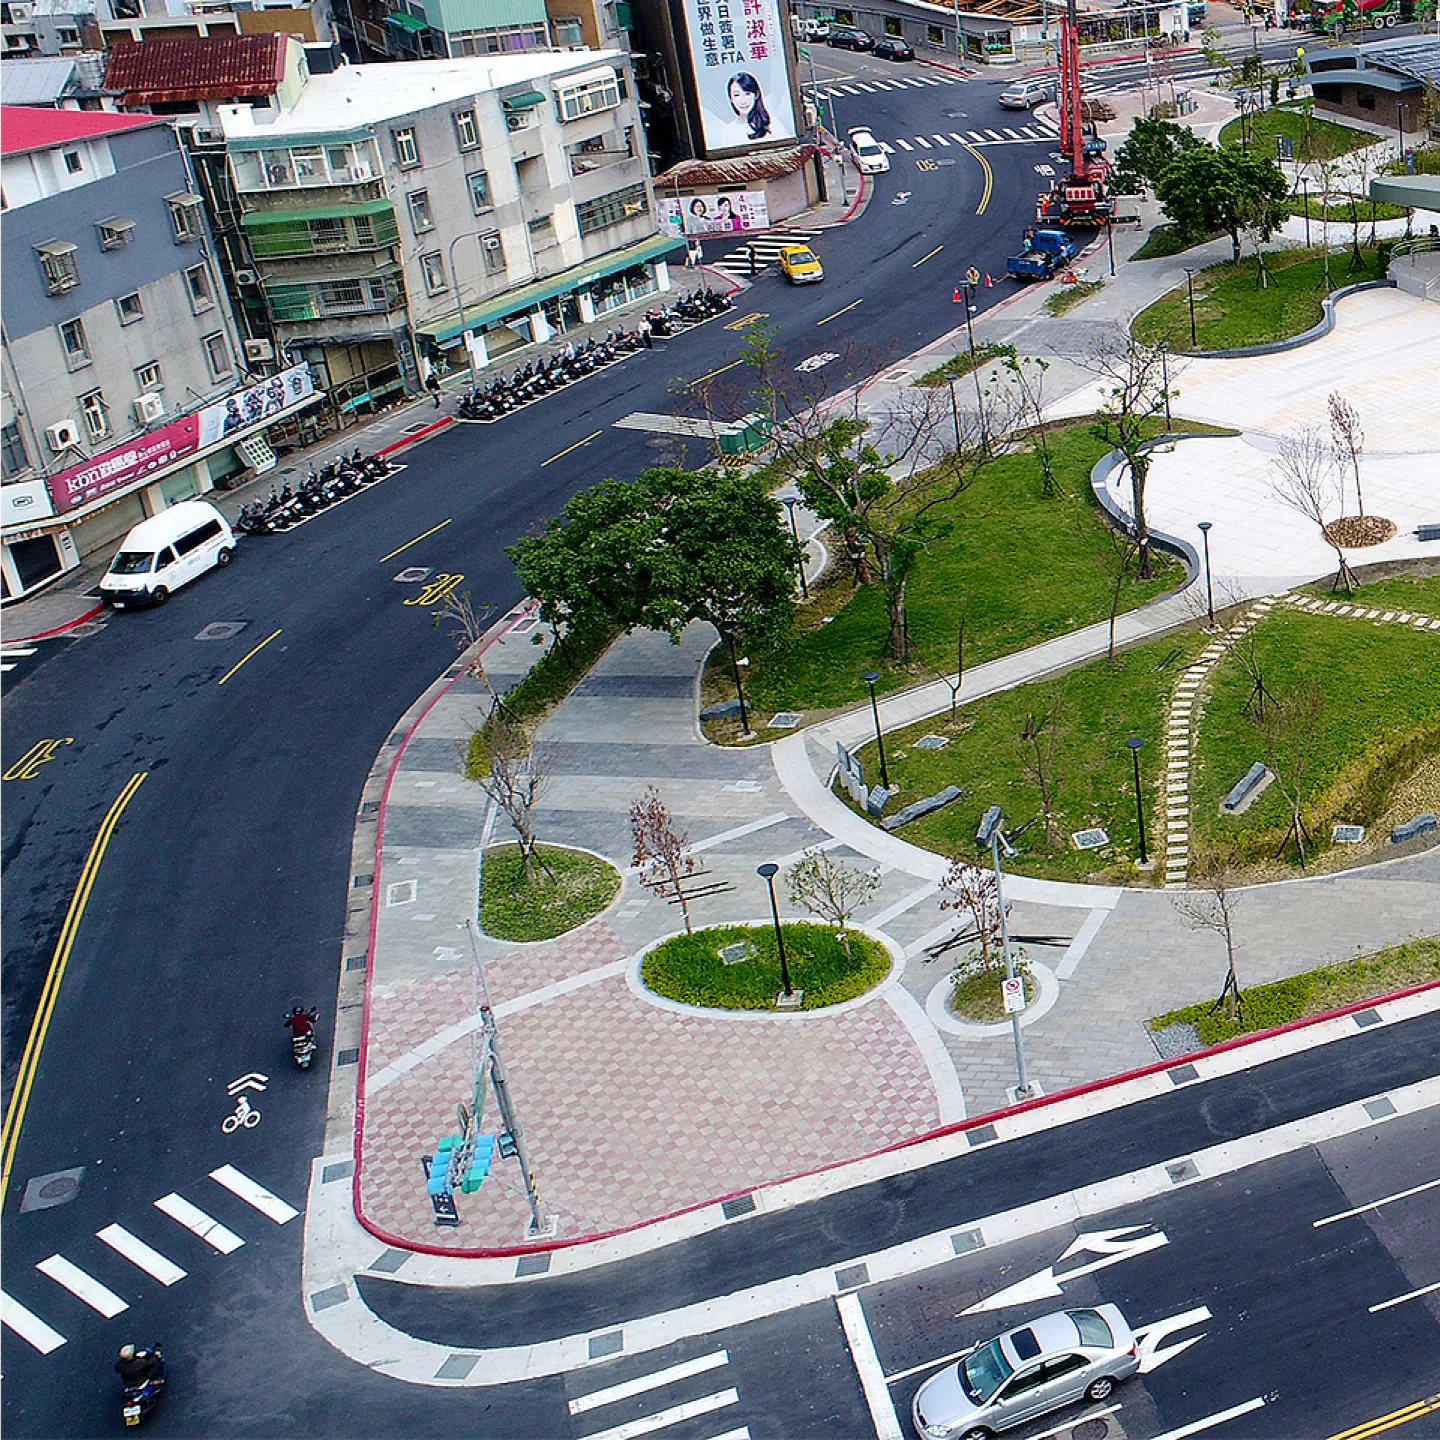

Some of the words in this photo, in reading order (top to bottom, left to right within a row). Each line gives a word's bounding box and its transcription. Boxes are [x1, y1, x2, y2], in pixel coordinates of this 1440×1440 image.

[720, 51, 746, 65] FTA
[403, 573, 465, 605] 30
[2, 737, 74, 780] 30
